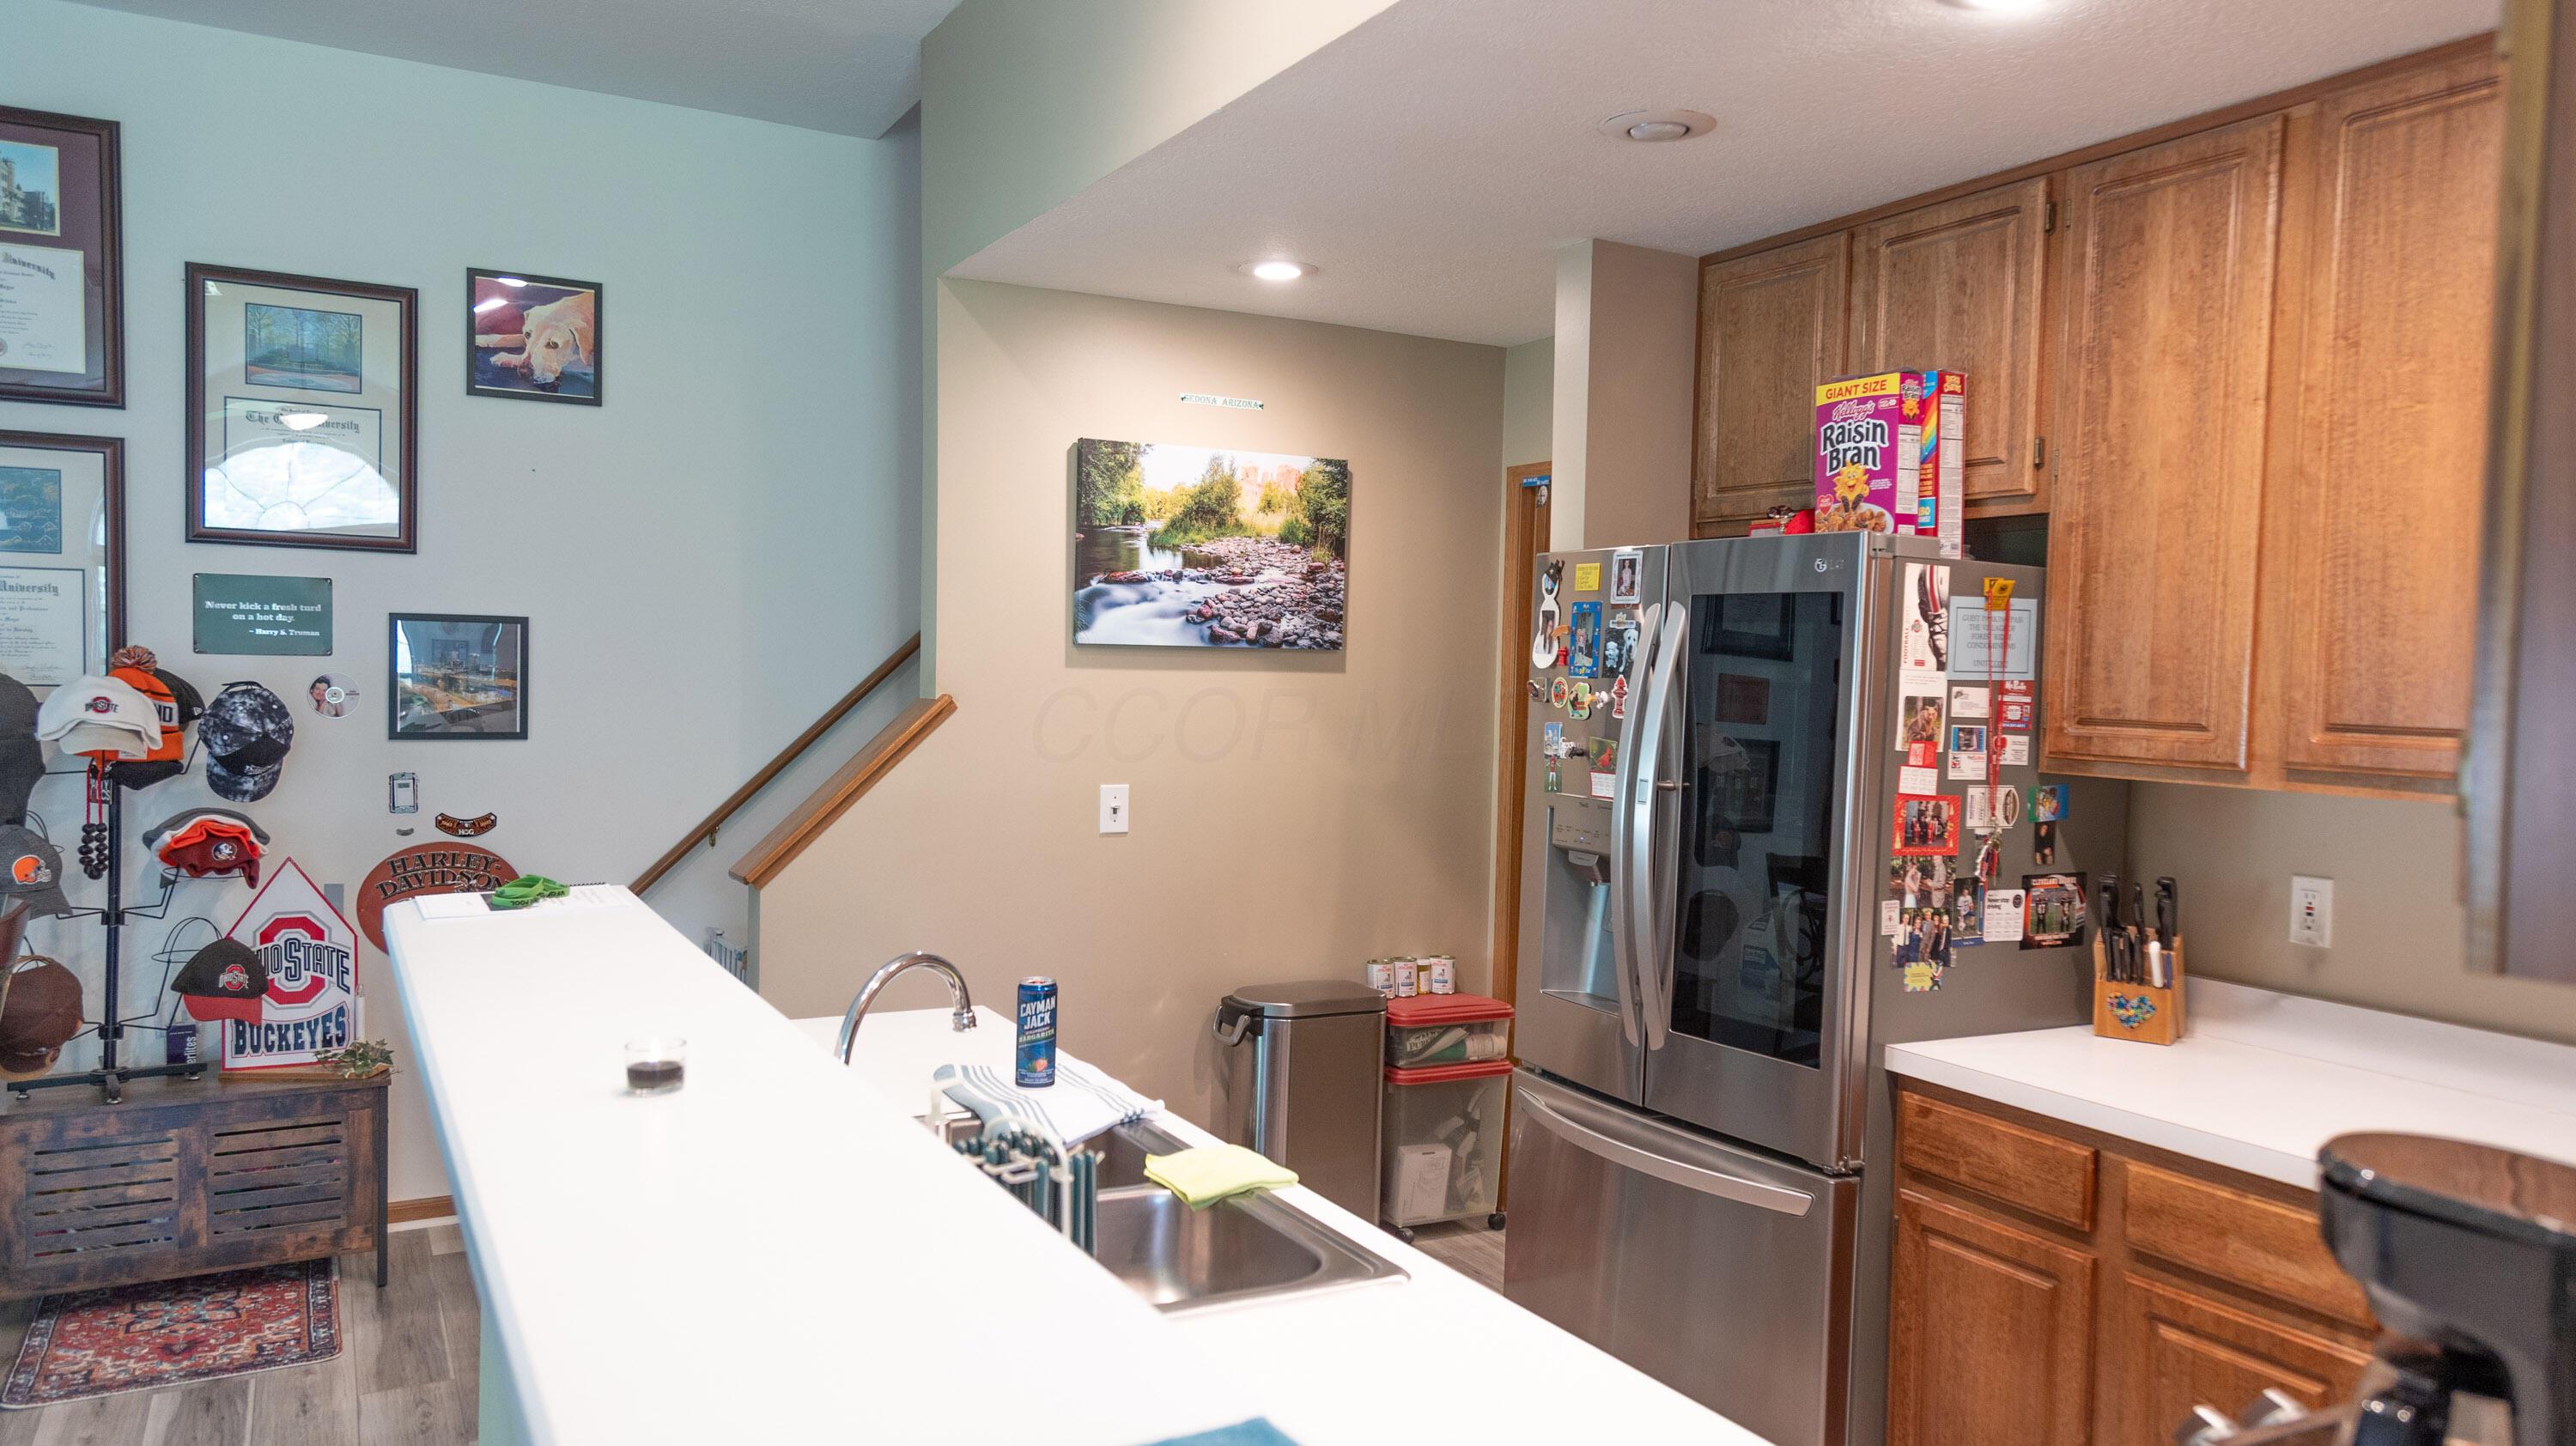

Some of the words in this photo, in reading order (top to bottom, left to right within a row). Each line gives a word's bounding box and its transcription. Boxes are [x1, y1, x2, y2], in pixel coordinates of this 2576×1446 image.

[1826, 384, 1860, 399] GIANT
[1862, 380, 1887, 394] SIZE
[1185, 395, 1217, 404] SEDONA
[1222, 398, 1259, 409] ARIZONA
[1832, 399, 1876, 422] Kellogg's
[1821, 420, 1887, 453] Raisin
[1827, 445, 1880, 474] Bran
[204, 601, 238, 610] Never
[239, 602, 262, 611] kick
[276, 614, 295, 623] day.
[388, 851, 502, 877] HARLEY-
[375, 868, 509, 900] DAVIDSON
[284, 938, 350, 994] STATE
[1021, 995, 1056, 1017] CAYMAN
[234, 1006, 347, 1055] BUCKEYES
[1024, 1012, 1051, 1030] JACK
